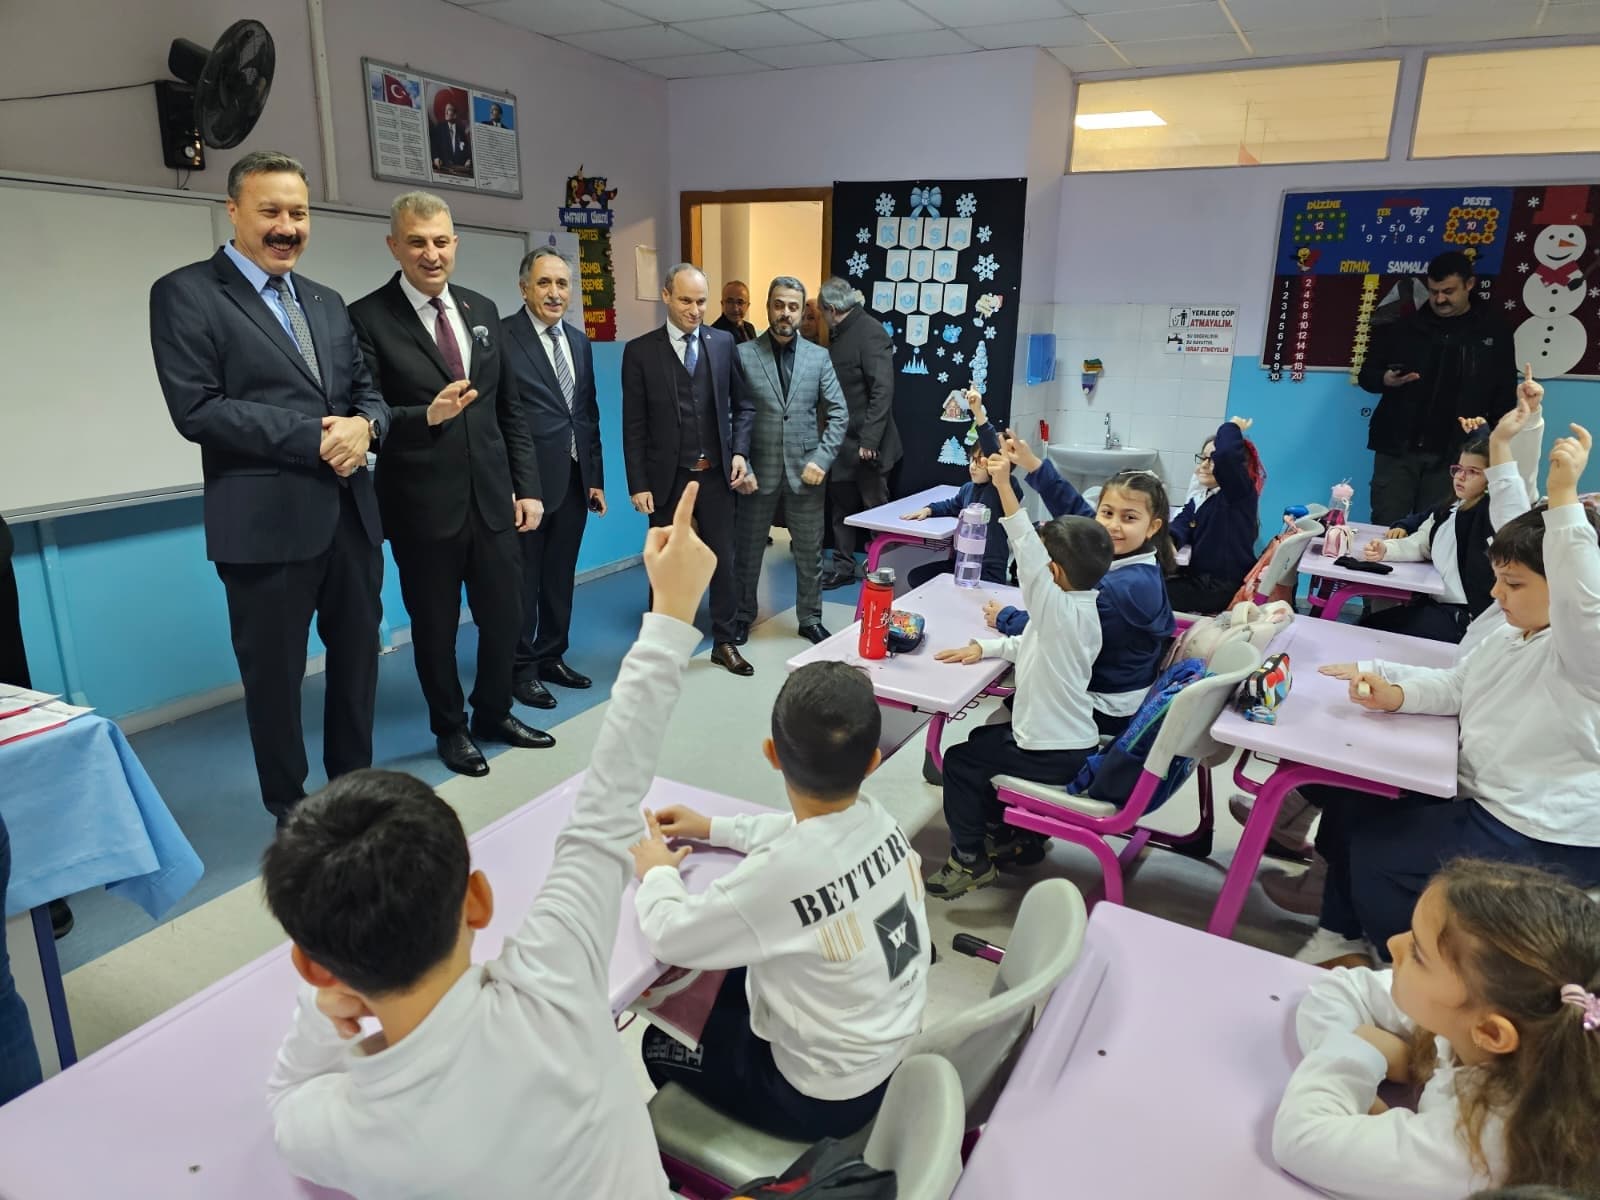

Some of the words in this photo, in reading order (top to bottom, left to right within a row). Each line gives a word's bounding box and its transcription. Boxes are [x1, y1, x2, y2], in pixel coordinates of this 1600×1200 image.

[1462, 197, 1492, 206] DESTE
[1377, 208, 1392, 217] TEK
[1376, 216, 1383, 225] 3
[1414, 215, 1422, 224] 2
[1314, 221, 1325, 230] 12
[1361, 224, 1366, 232] 1
[1389, 224, 1396, 232] 5
[1399, 224, 1406, 232] 0
[1427, 225, 1434, 233] 4
[1466, 221, 1477, 230] 10
[1366, 234, 1373, 243] 9
[1380, 235, 1387, 243] 7
[1406, 235, 1413, 243] 8
[1418, 235, 1426, 244] 6
[1339, 260, 1371, 273] RİTMİK
[1387, 260, 1429, 274] SAYMALA
[1305, 279, 1312, 287] 2
[1480, 280, 1491, 289] 10
[1282, 291, 1289, 300] 2
[1303, 290, 1310, 298] 4
[1281, 302, 1288, 310] 3
[1303, 301, 1309, 309] 6
[1221, 309, 1235, 318] ÇÖP
[1279, 312, 1286, 320] 4
[1302, 312, 1308, 320] 8
[1278, 322, 1285, 330] 5
[1300, 321, 1309, 329] 10
[1277, 332, 1284, 340] 6
[1298, 331, 1307, 339] 12
[1276, 343, 1283, 351] 7
[1296, 342, 1306, 350] 14
[1273, 362, 1280, 370] 9
[1271, 372, 1280, 380] 10
[1291, 372, 1302, 380] 20
[887, 921, 907, 949] W
